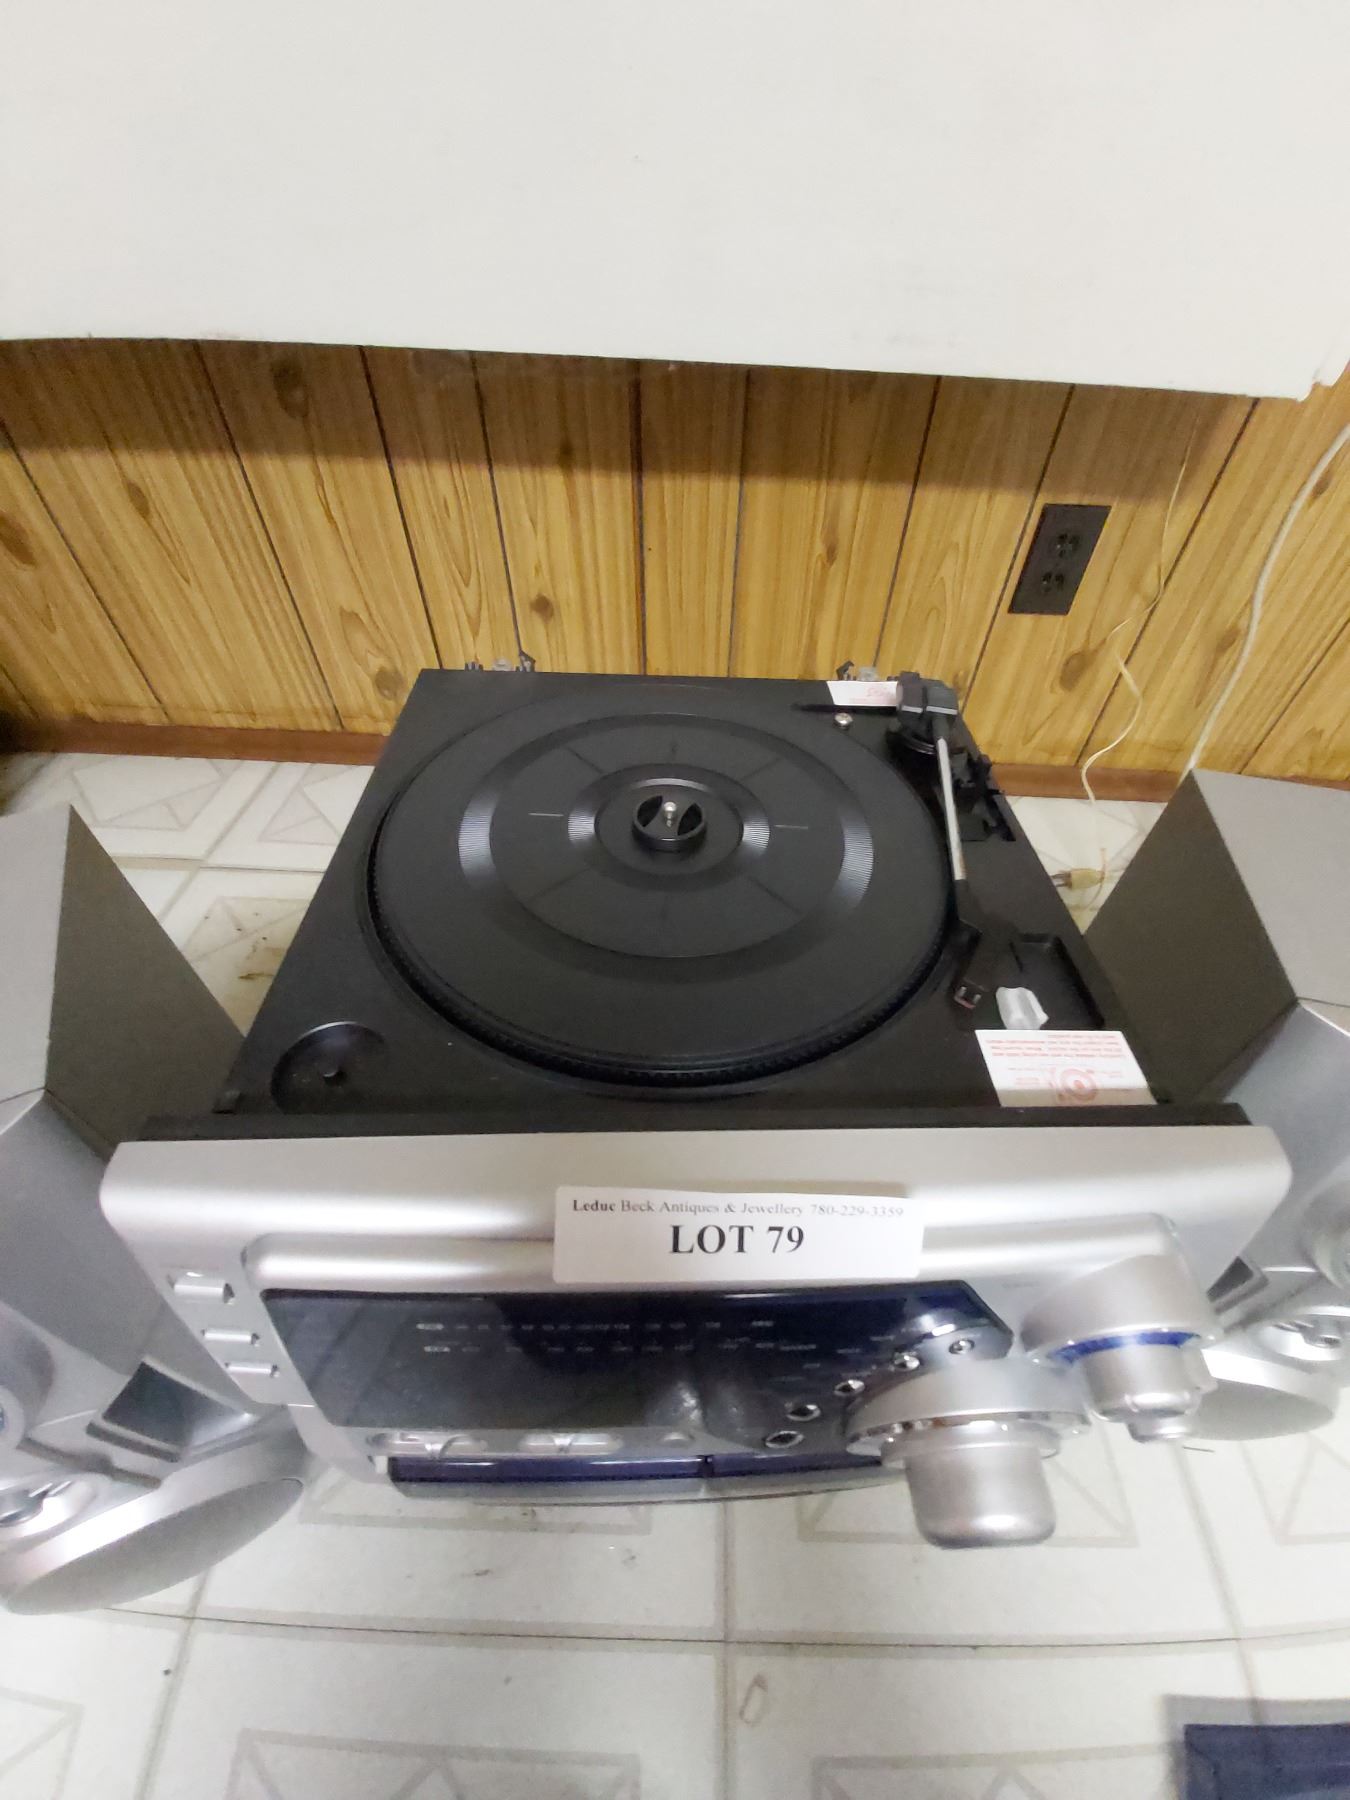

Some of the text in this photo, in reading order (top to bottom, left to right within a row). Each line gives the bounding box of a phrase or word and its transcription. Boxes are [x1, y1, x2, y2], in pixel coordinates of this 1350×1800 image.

[572, 1199, 616, 1212] Leduc
[620, 1199, 655, 1212] Beck
[659, 1200, 720, 1215] Antiques
[724, 1203, 736, 1213] &
[740, 1202, 803, 1217] Jewellery
[669, 1225, 806, 1254] LOT 79
